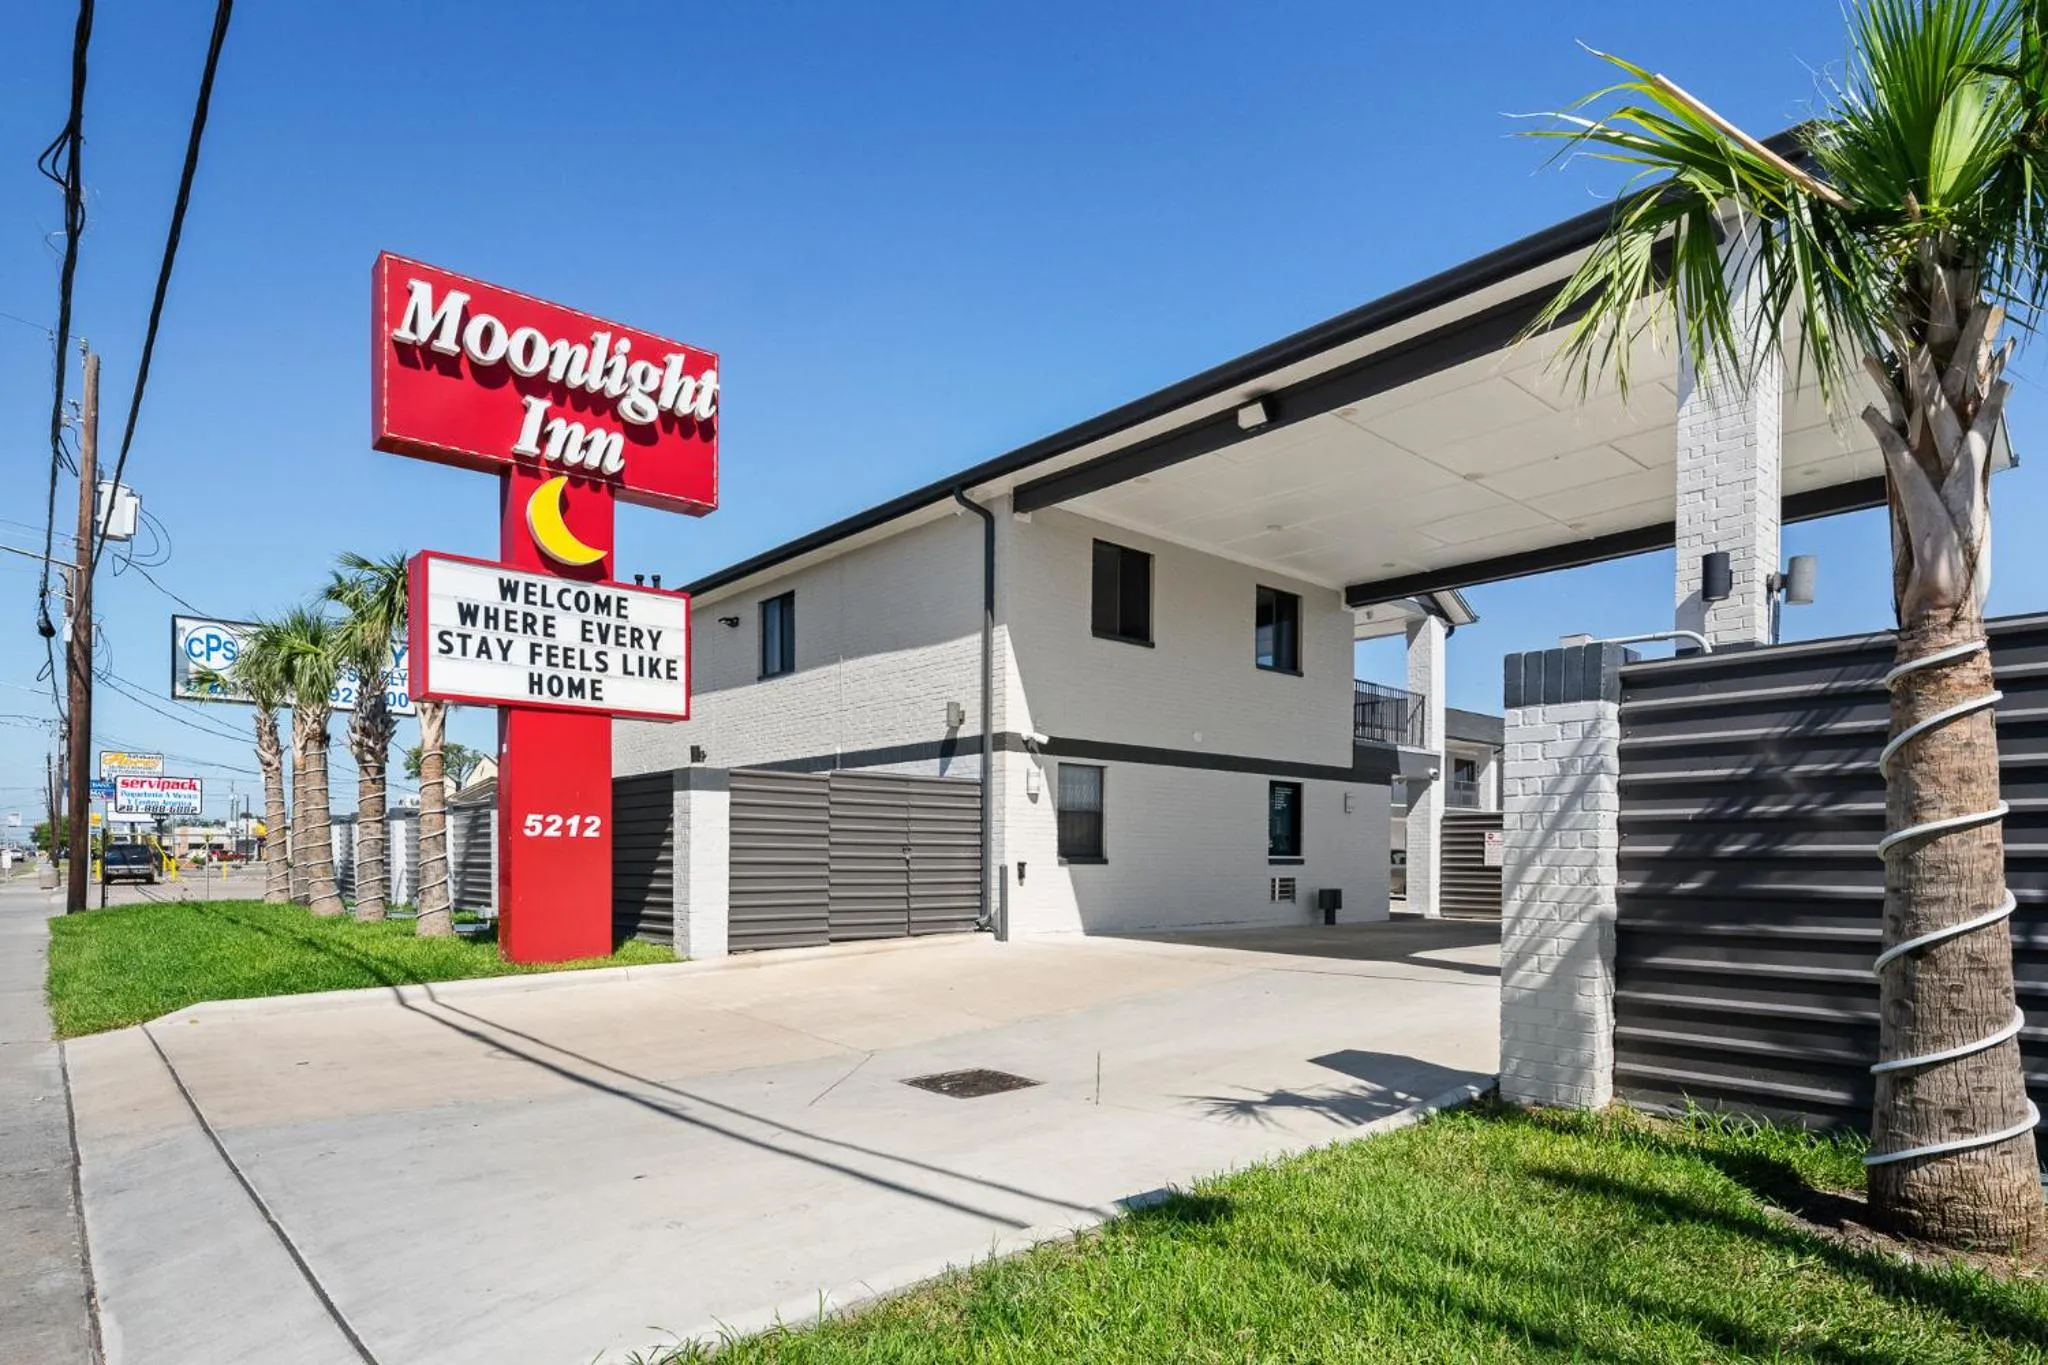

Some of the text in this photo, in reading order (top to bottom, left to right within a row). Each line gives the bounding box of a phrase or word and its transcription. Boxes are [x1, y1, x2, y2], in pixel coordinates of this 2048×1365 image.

[391, 278, 720, 425] Moonlight
[512, 395, 625, 475] Inn
[498, 577, 629, 619] WELCOME
[187, 633, 237, 662] CPS
[457, 602, 662, 651] WHERE EVERY
[438, 631, 514, 662] STAY
[529, 643, 609, 673] FEELS
[622, 654, 678, 680] LIKE
[528, 672, 604, 701] HOME
[120, 777, 197, 791] servipack
[523, 814, 601, 838] 5212
